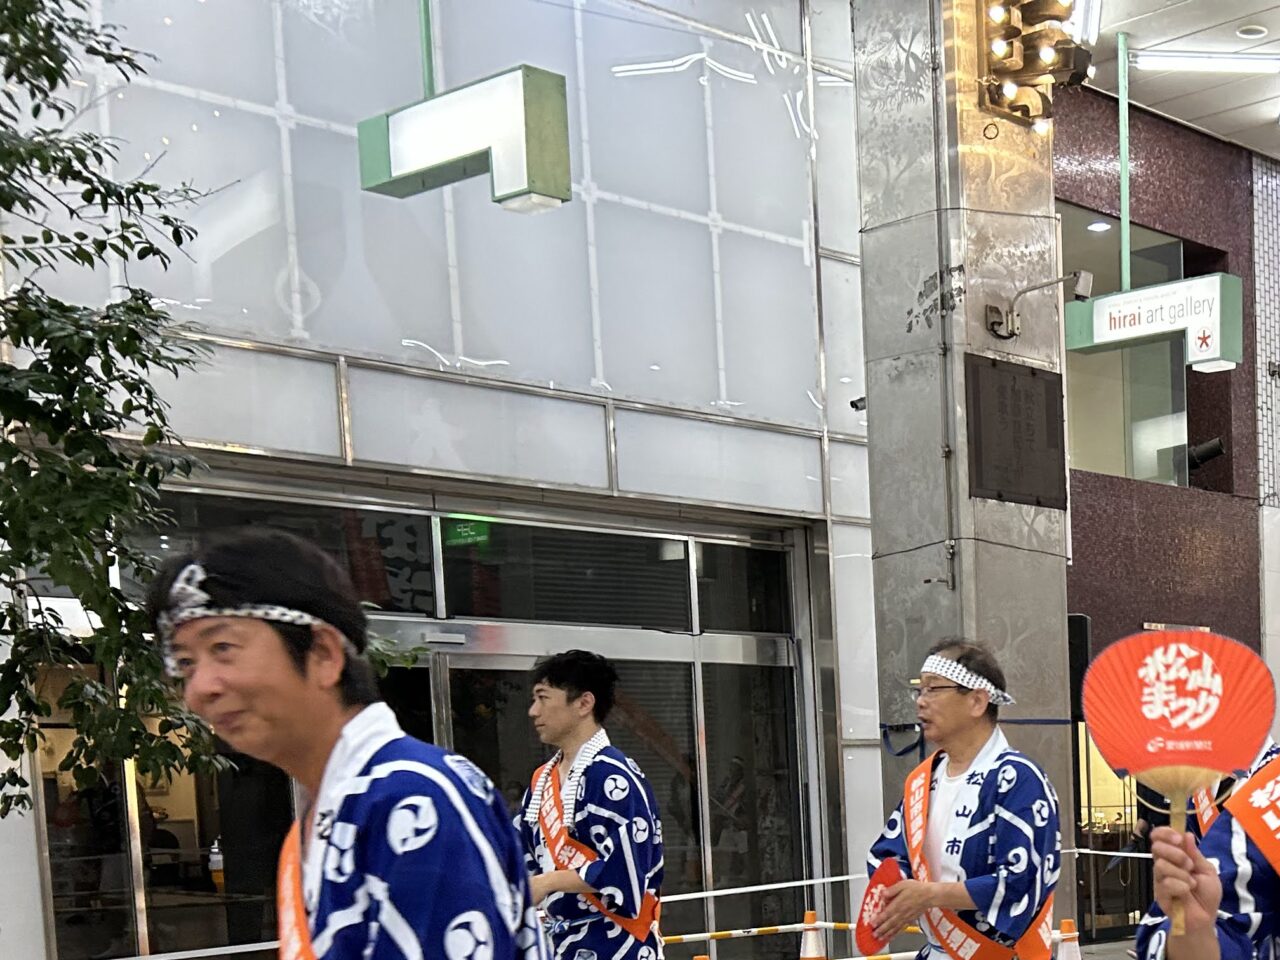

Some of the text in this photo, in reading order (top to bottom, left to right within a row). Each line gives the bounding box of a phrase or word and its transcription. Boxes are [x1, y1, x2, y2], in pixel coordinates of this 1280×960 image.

[1108, 306, 1142, 331] hirai
[1146, 304, 1165, 324] art
[1168, 295, 1216, 325] gallery
[1140, 681, 1221, 731] まつり
[945, 769, 985, 856] 松山市
